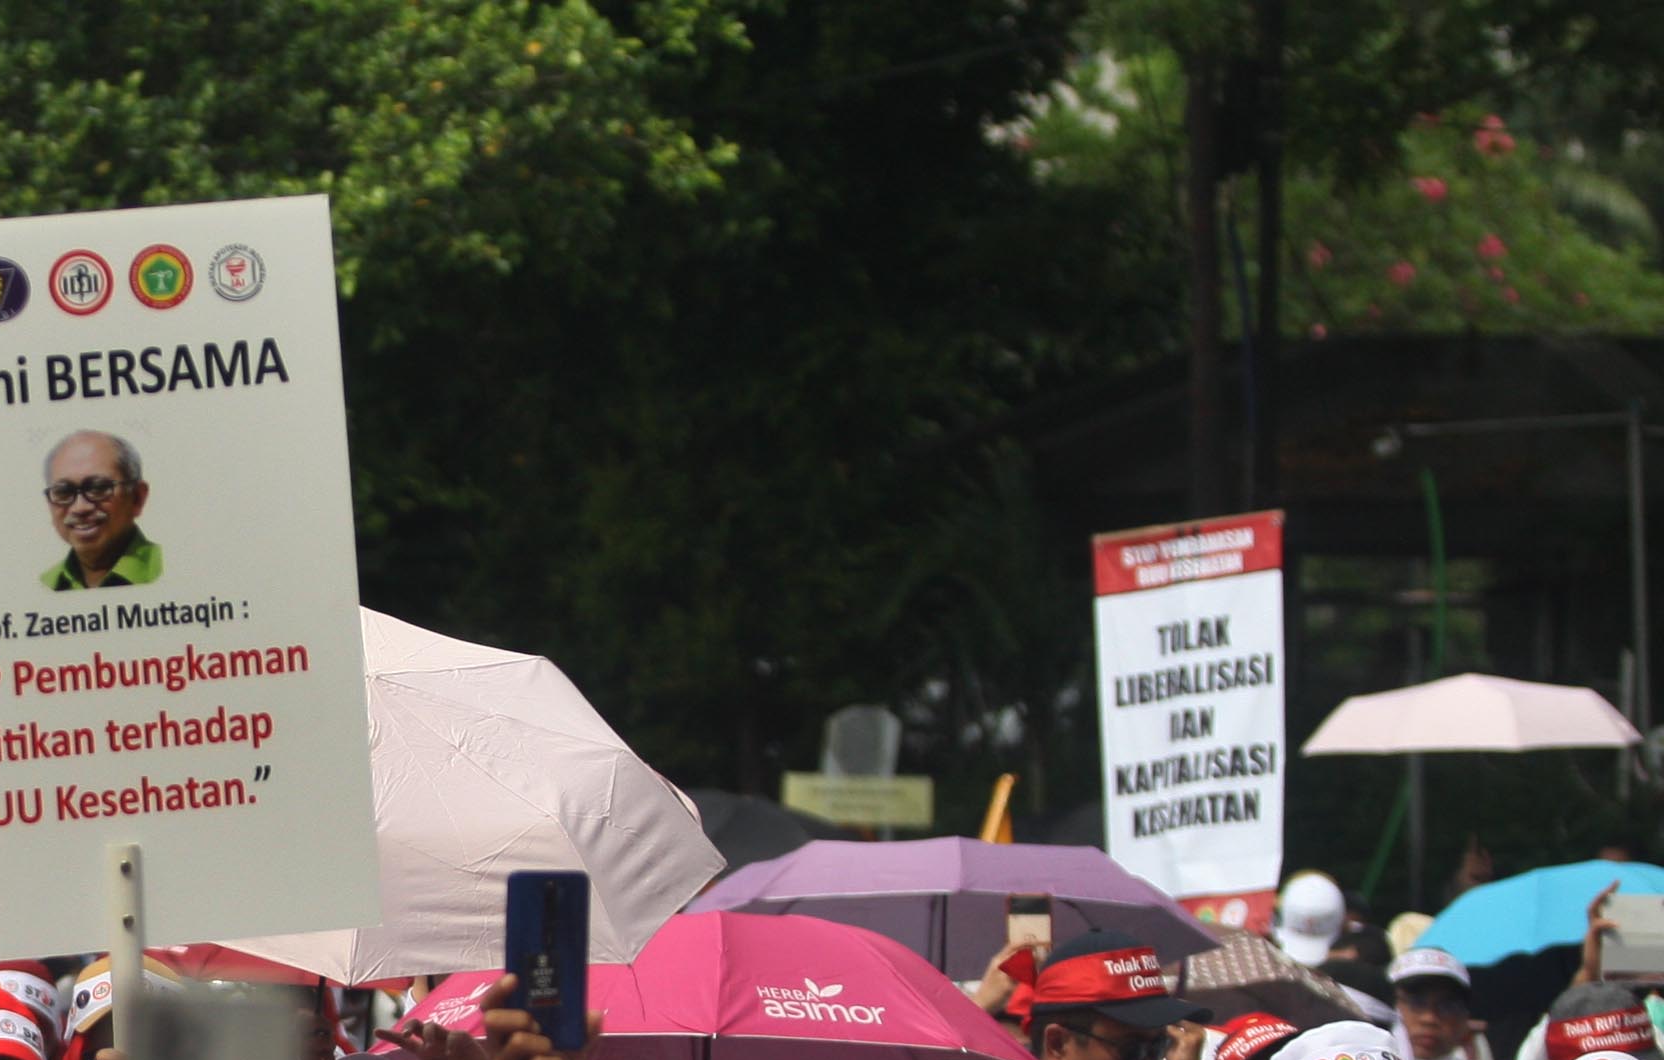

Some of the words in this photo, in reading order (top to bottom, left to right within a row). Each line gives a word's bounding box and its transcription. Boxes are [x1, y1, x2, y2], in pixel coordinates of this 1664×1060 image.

[45, 337, 290, 402] BERSAMA
[25, 605, 109, 638] Zaenal
[117, 597, 234, 630] Muttaqin
[1156, 615, 1232, 655] TOLAK
[13, 643, 309, 696] Pembungkaman
[1115, 652, 1274, 706] LIBERALISASI
[106, 706, 274, 752] terhadap
[56, 764, 272, 821] Kesehatan.”
[1116, 742, 1277, 797] KAPITALISASI
[1133, 788, 1261, 839] KESEHATAN
[1104, 955, 1141, 976] Tolak
[756, 985, 820, 1002] HERBA
[763, 998, 885, 1025] asimor
[1596, 1014, 1622, 1032] RUU
